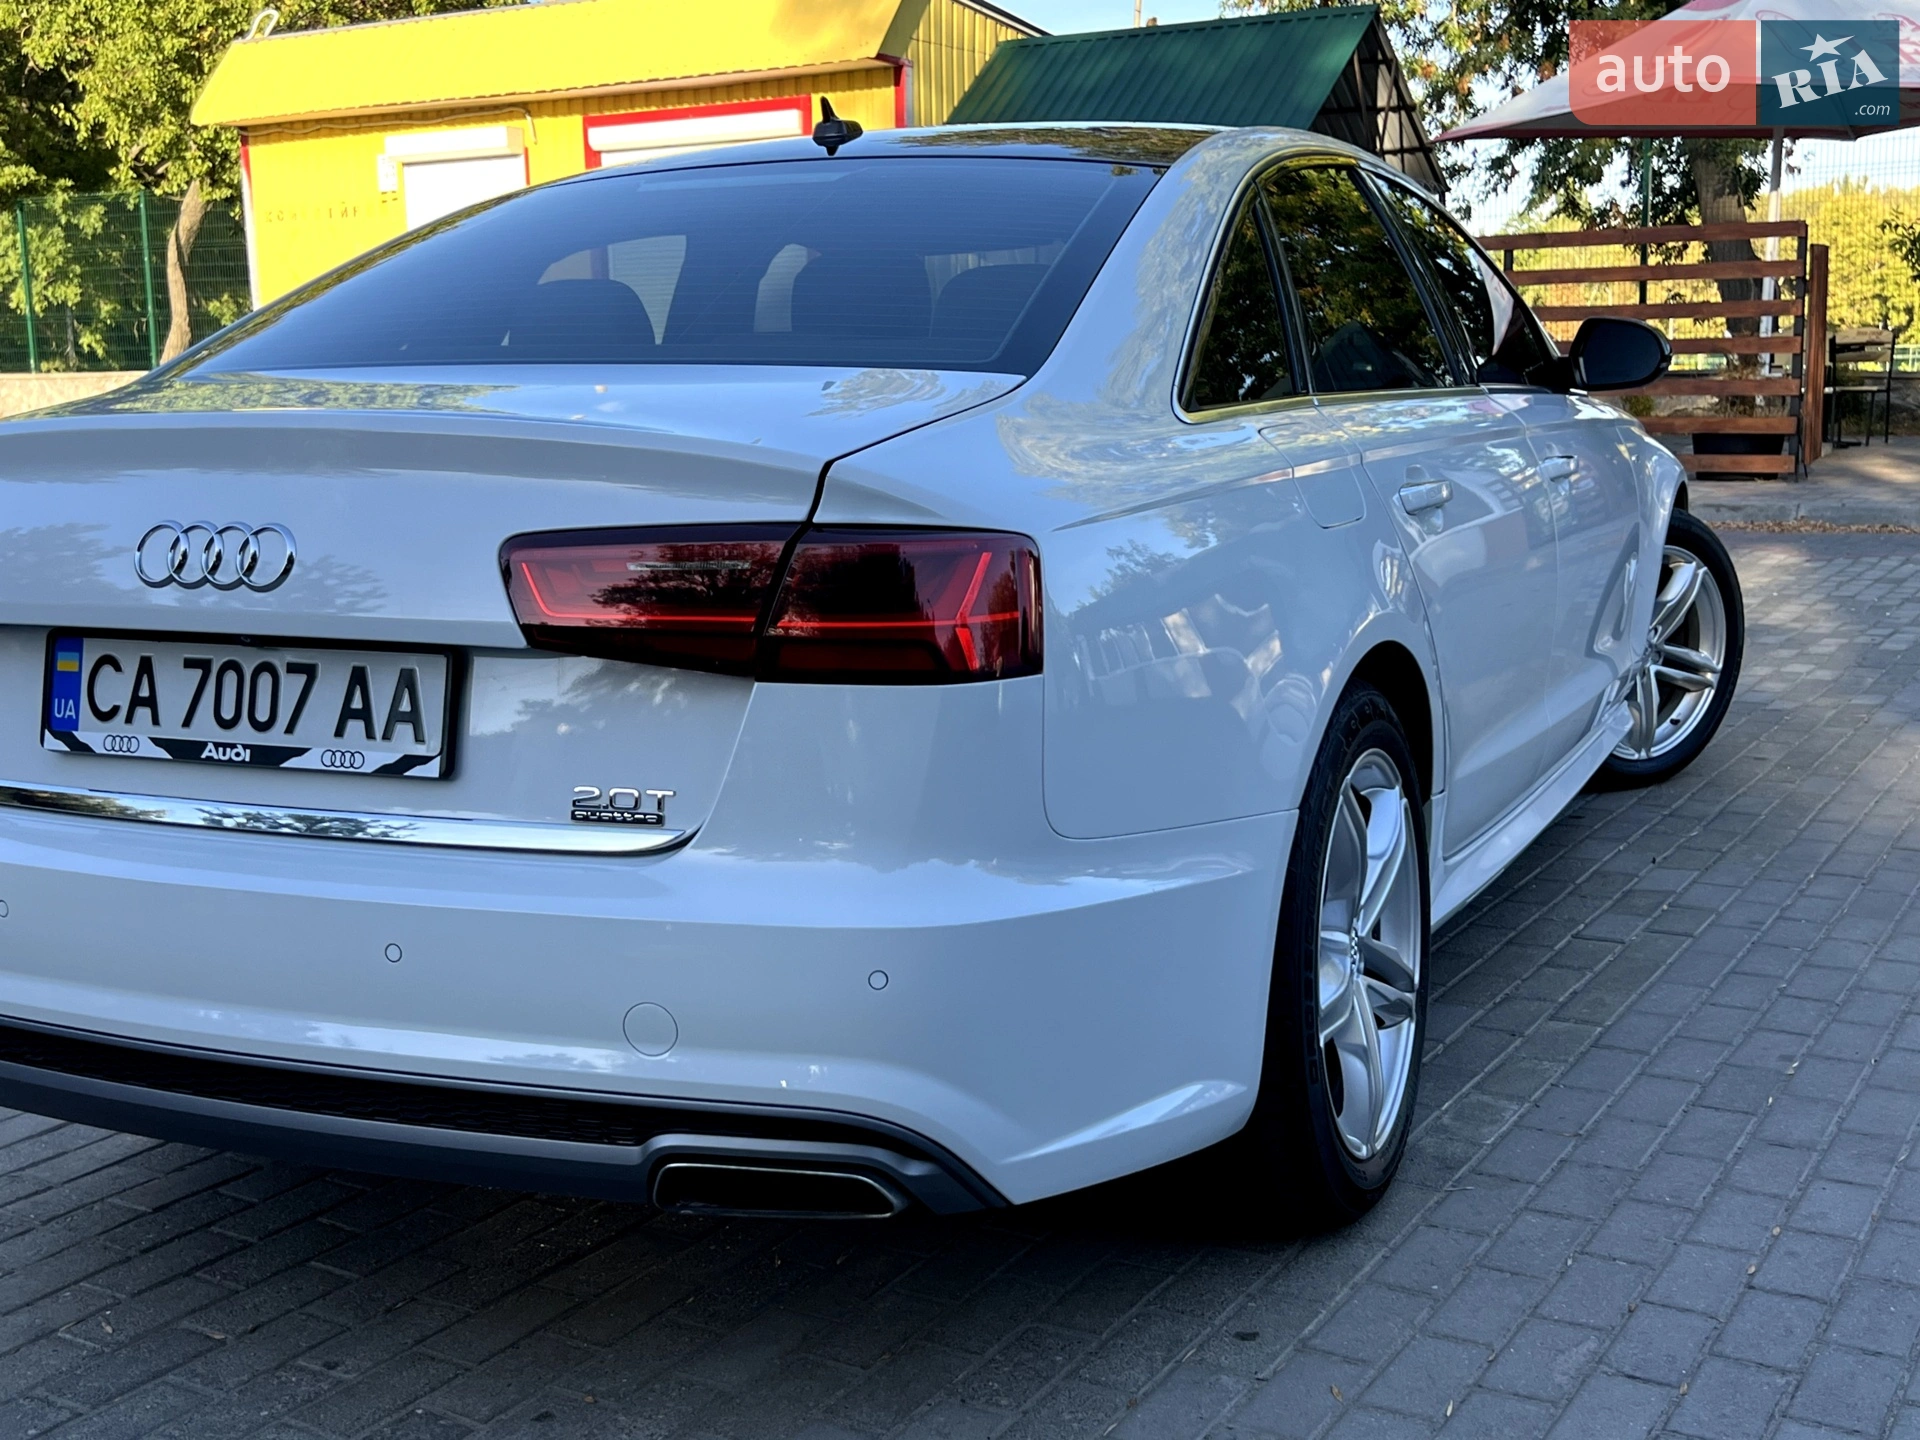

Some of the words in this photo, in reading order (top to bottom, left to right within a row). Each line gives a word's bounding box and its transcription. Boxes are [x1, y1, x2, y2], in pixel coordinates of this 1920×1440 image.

[54, 698, 76, 720] UA
[87, 653, 161, 727] CA
[181, 656, 320, 735] 7007
[333, 664, 427, 744] AA
[200, 742, 251, 762] Audi
